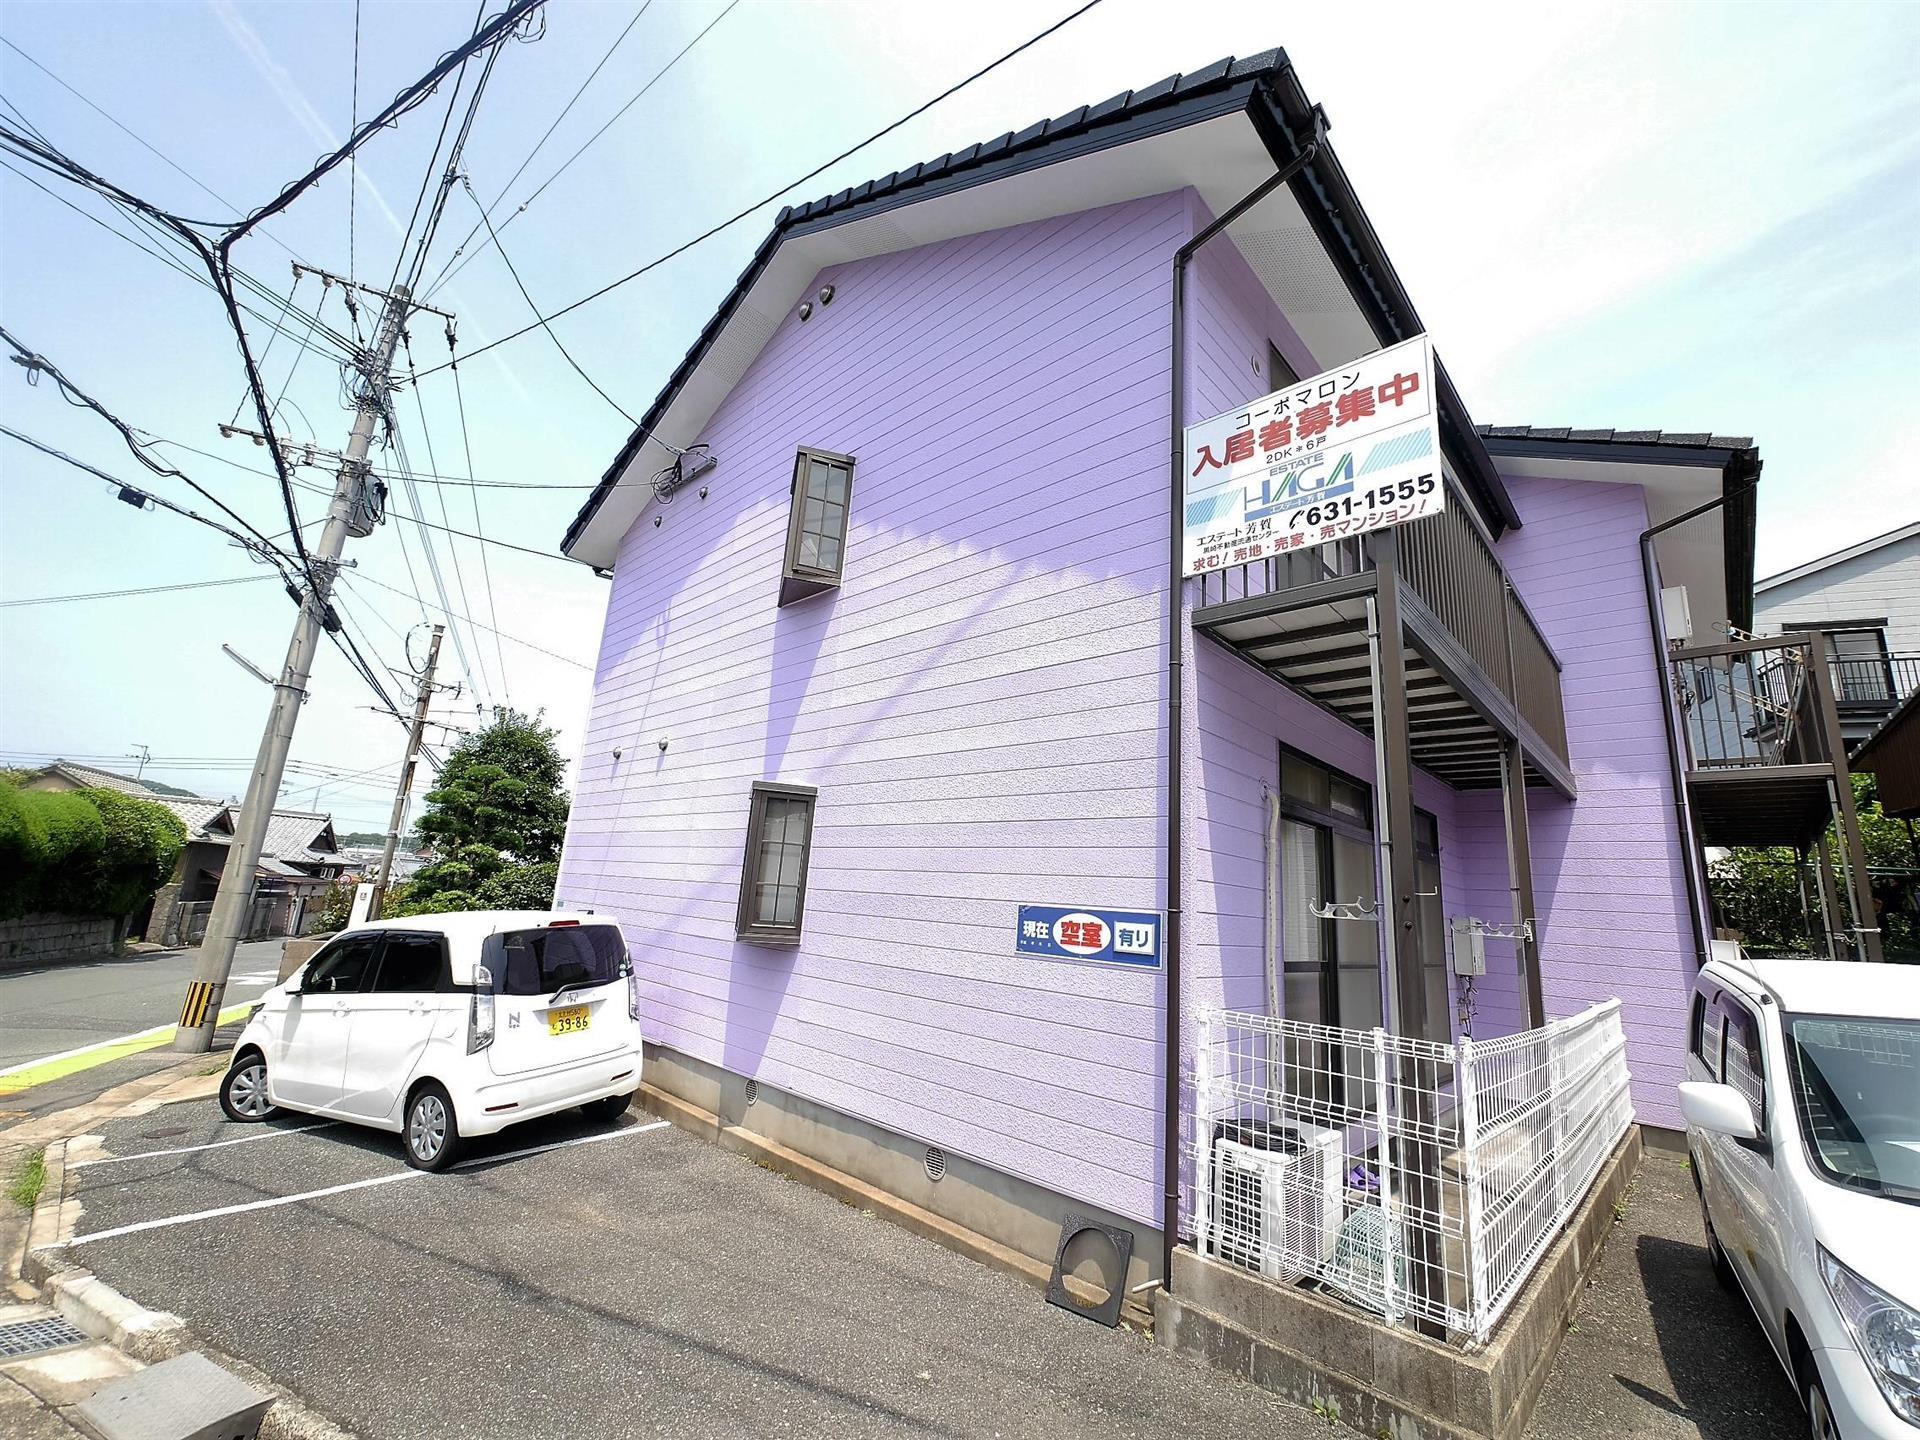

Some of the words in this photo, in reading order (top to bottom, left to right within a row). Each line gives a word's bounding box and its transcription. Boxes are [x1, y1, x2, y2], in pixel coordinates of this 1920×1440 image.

[1192, 372, 1420, 477] 入居者募集中
[1236, 371, 1361, 430] コーポマロン
[1244, 451, 1354, 511] HAGA
[1269, 452, 1324, 477] ESTATE
[1306, 473, 1435, 526] 631-1555
[1022, 920, 1050, 939] 現在
[1060, 920, 1103, 949] 空室
[558, 1015, 588, 1031] 39-86
